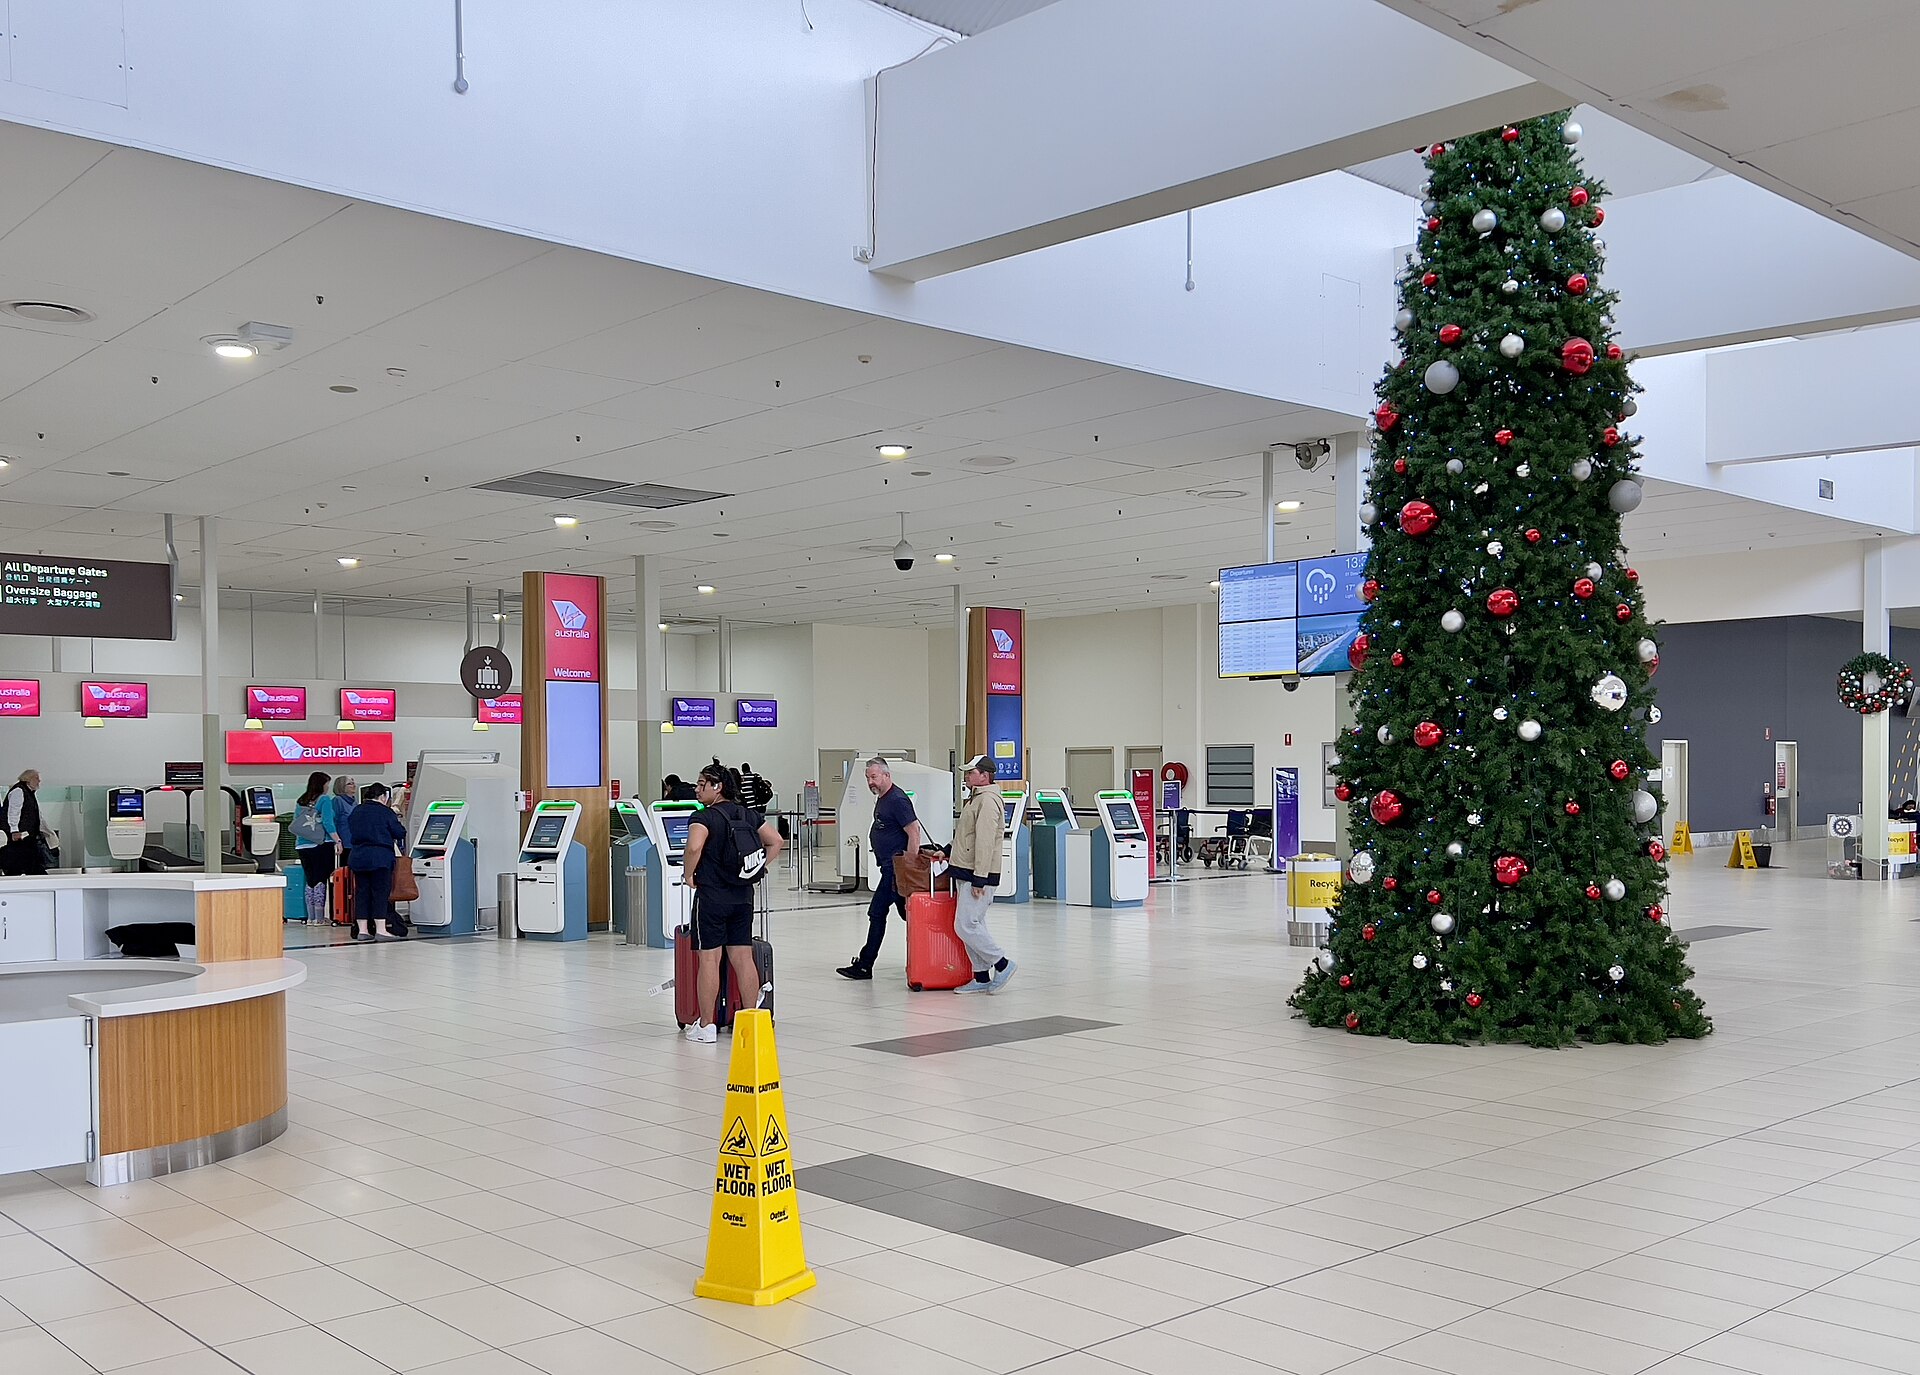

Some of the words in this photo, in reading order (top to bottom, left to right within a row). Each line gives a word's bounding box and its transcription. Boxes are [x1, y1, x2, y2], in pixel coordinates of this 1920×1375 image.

[4, 561, 21, 572] All
[22, 563, 76, 575] Departure
[77, 566, 108, 578] Gates
[5, 584, 51, 597] Oversize
[53, 587, 98, 600] Baggage
[554, 628, 590, 639] australia
[552, 667, 592, 679] Welcome
[0, 688, 31, 697] ustralia
[105, 691, 140, 700] australia
[268, 694, 299, 703] australia
[360, 697, 389, 705] australia
[3, 702, 21, 710] drop
[262, 706, 275, 714] bag
[354, 708, 366, 716] bag
[490, 711, 501, 719] bag
[303, 746, 361, 757] australia
[744, 848, 765, 871] NIKE
[726, 1083, 755, 1094] CAUTION
[758, 1081, 780, 1093] CAUTION
[723, 1162, 750, 1180] WET
[765, 1159, 786, 1178] WET
[716, 1178, 756, 1197] FLOOR
[761, 1173, 792, 1196] FLOOR
[722, 1212, 744, 1222] Oates
[769, 1209, 786, 1220] Oates
